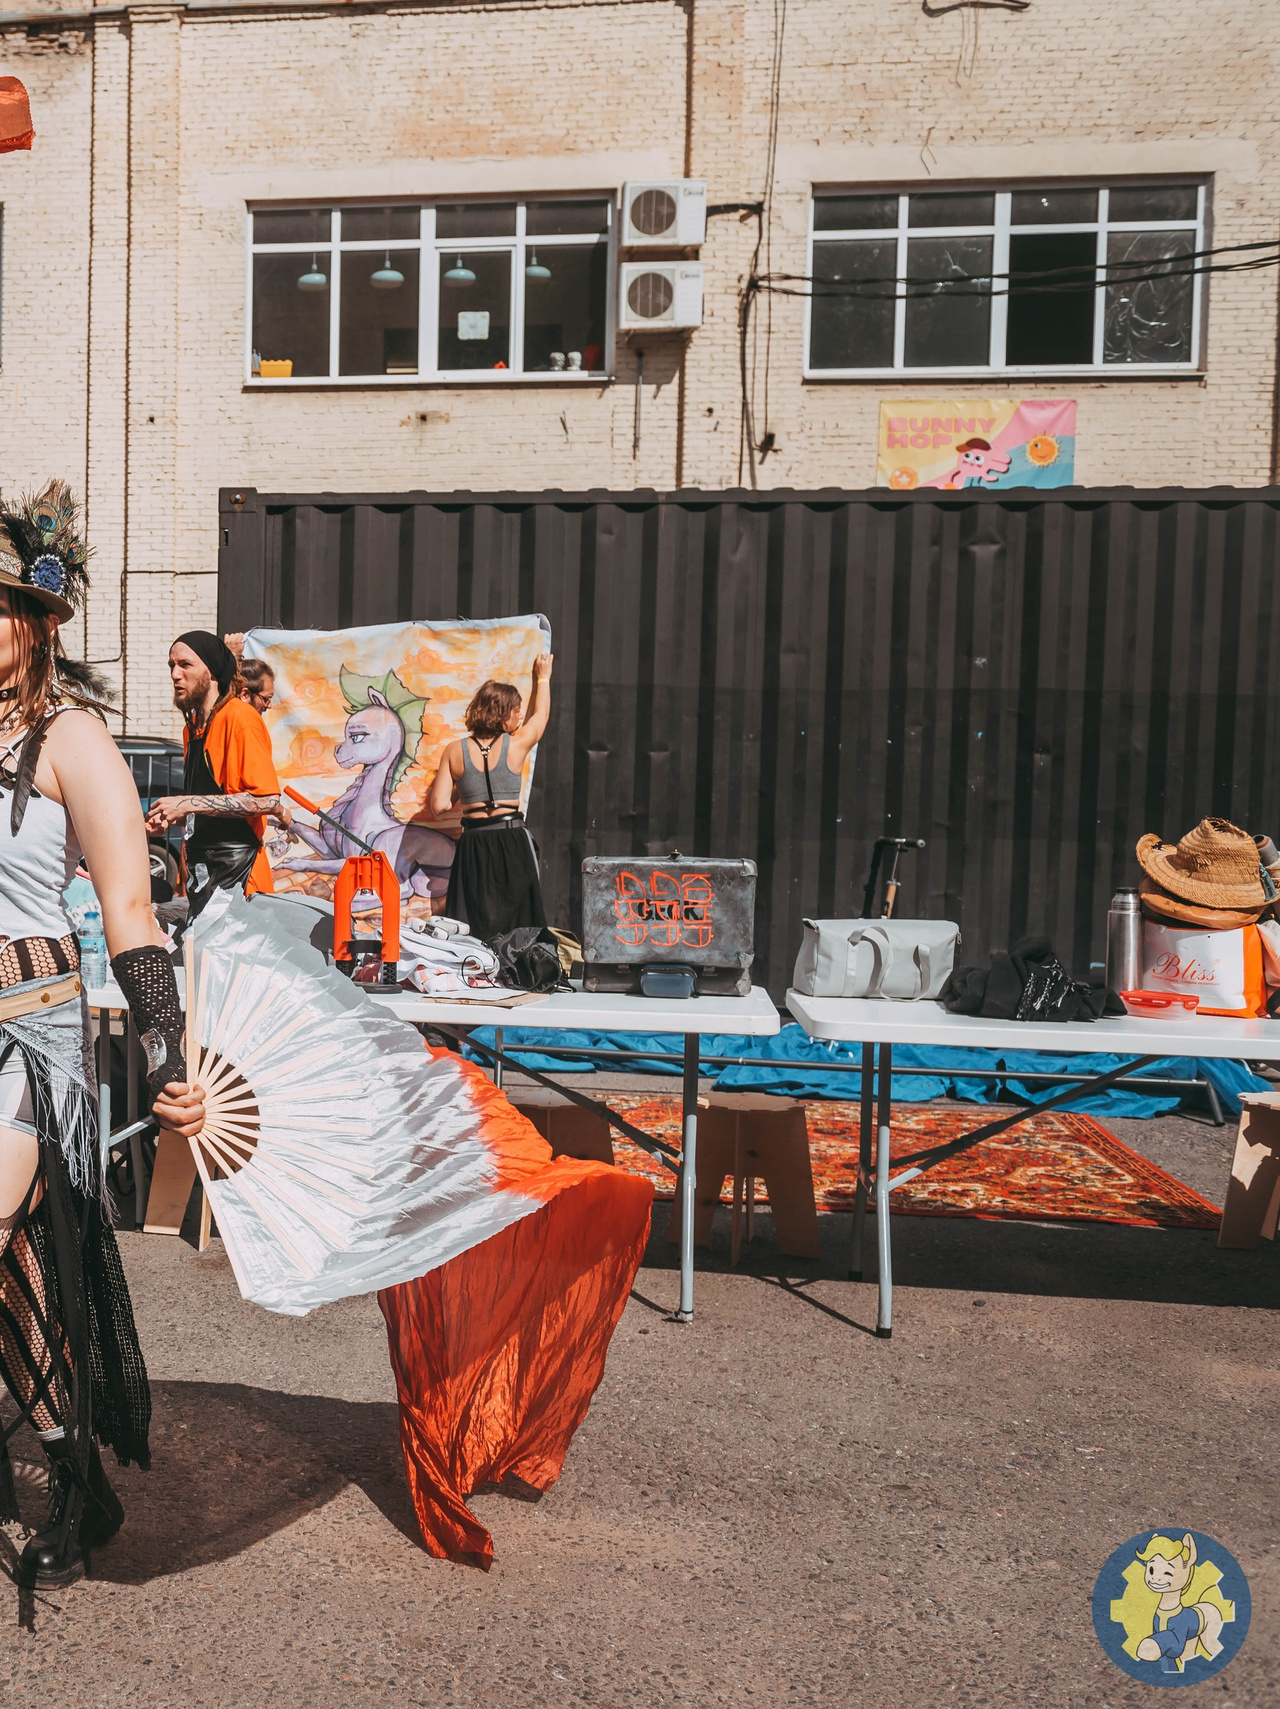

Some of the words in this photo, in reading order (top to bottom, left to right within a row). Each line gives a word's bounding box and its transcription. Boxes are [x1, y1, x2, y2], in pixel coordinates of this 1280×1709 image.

[887, 417, 996, 433] BUNNY
[886, 433, 953, 449] HOP
[1152, 952, 1216, 981] Bliss
